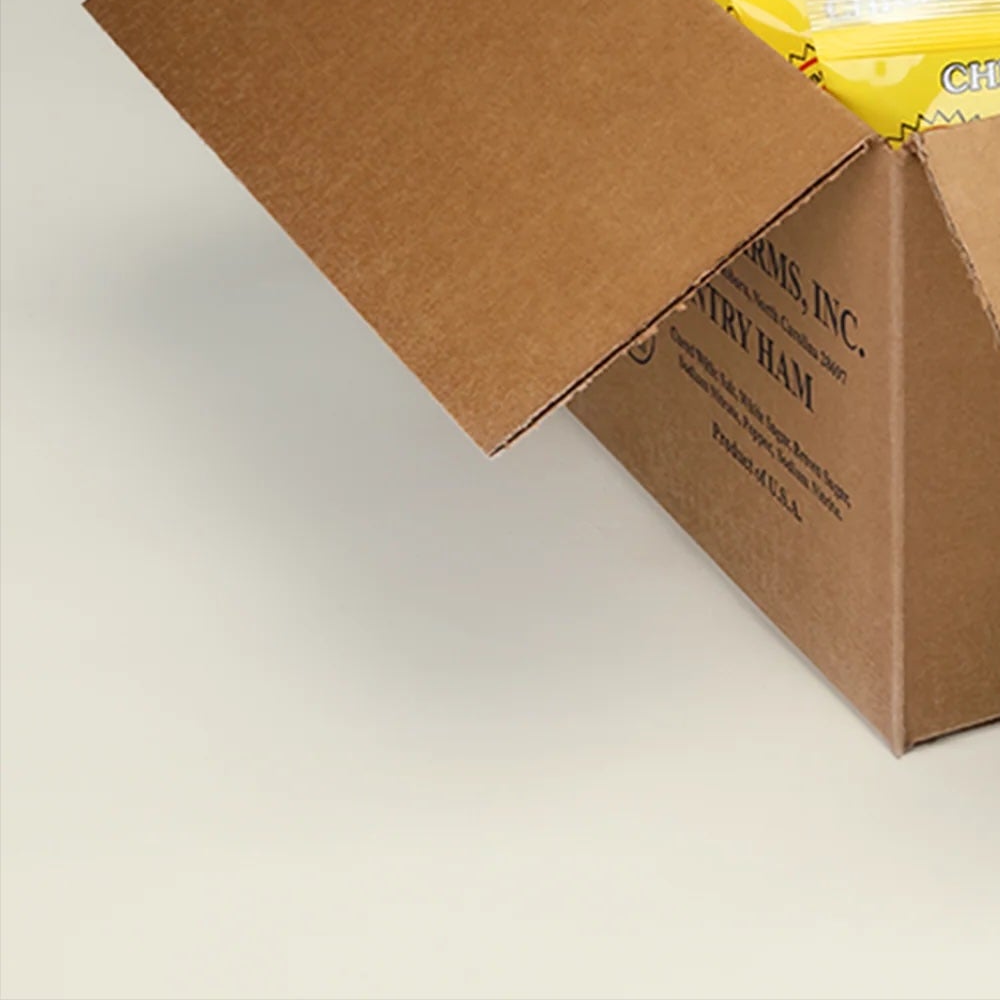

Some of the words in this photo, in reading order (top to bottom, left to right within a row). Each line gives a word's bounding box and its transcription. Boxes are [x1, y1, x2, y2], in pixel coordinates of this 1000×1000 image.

[743, 238, 808, 315] RMS,
[812, 279, 865, 358] INC.
[756, 325, 815, 413] HAM
[712, 420, 753, 474] Product
[754, 468, 767, 487] of
